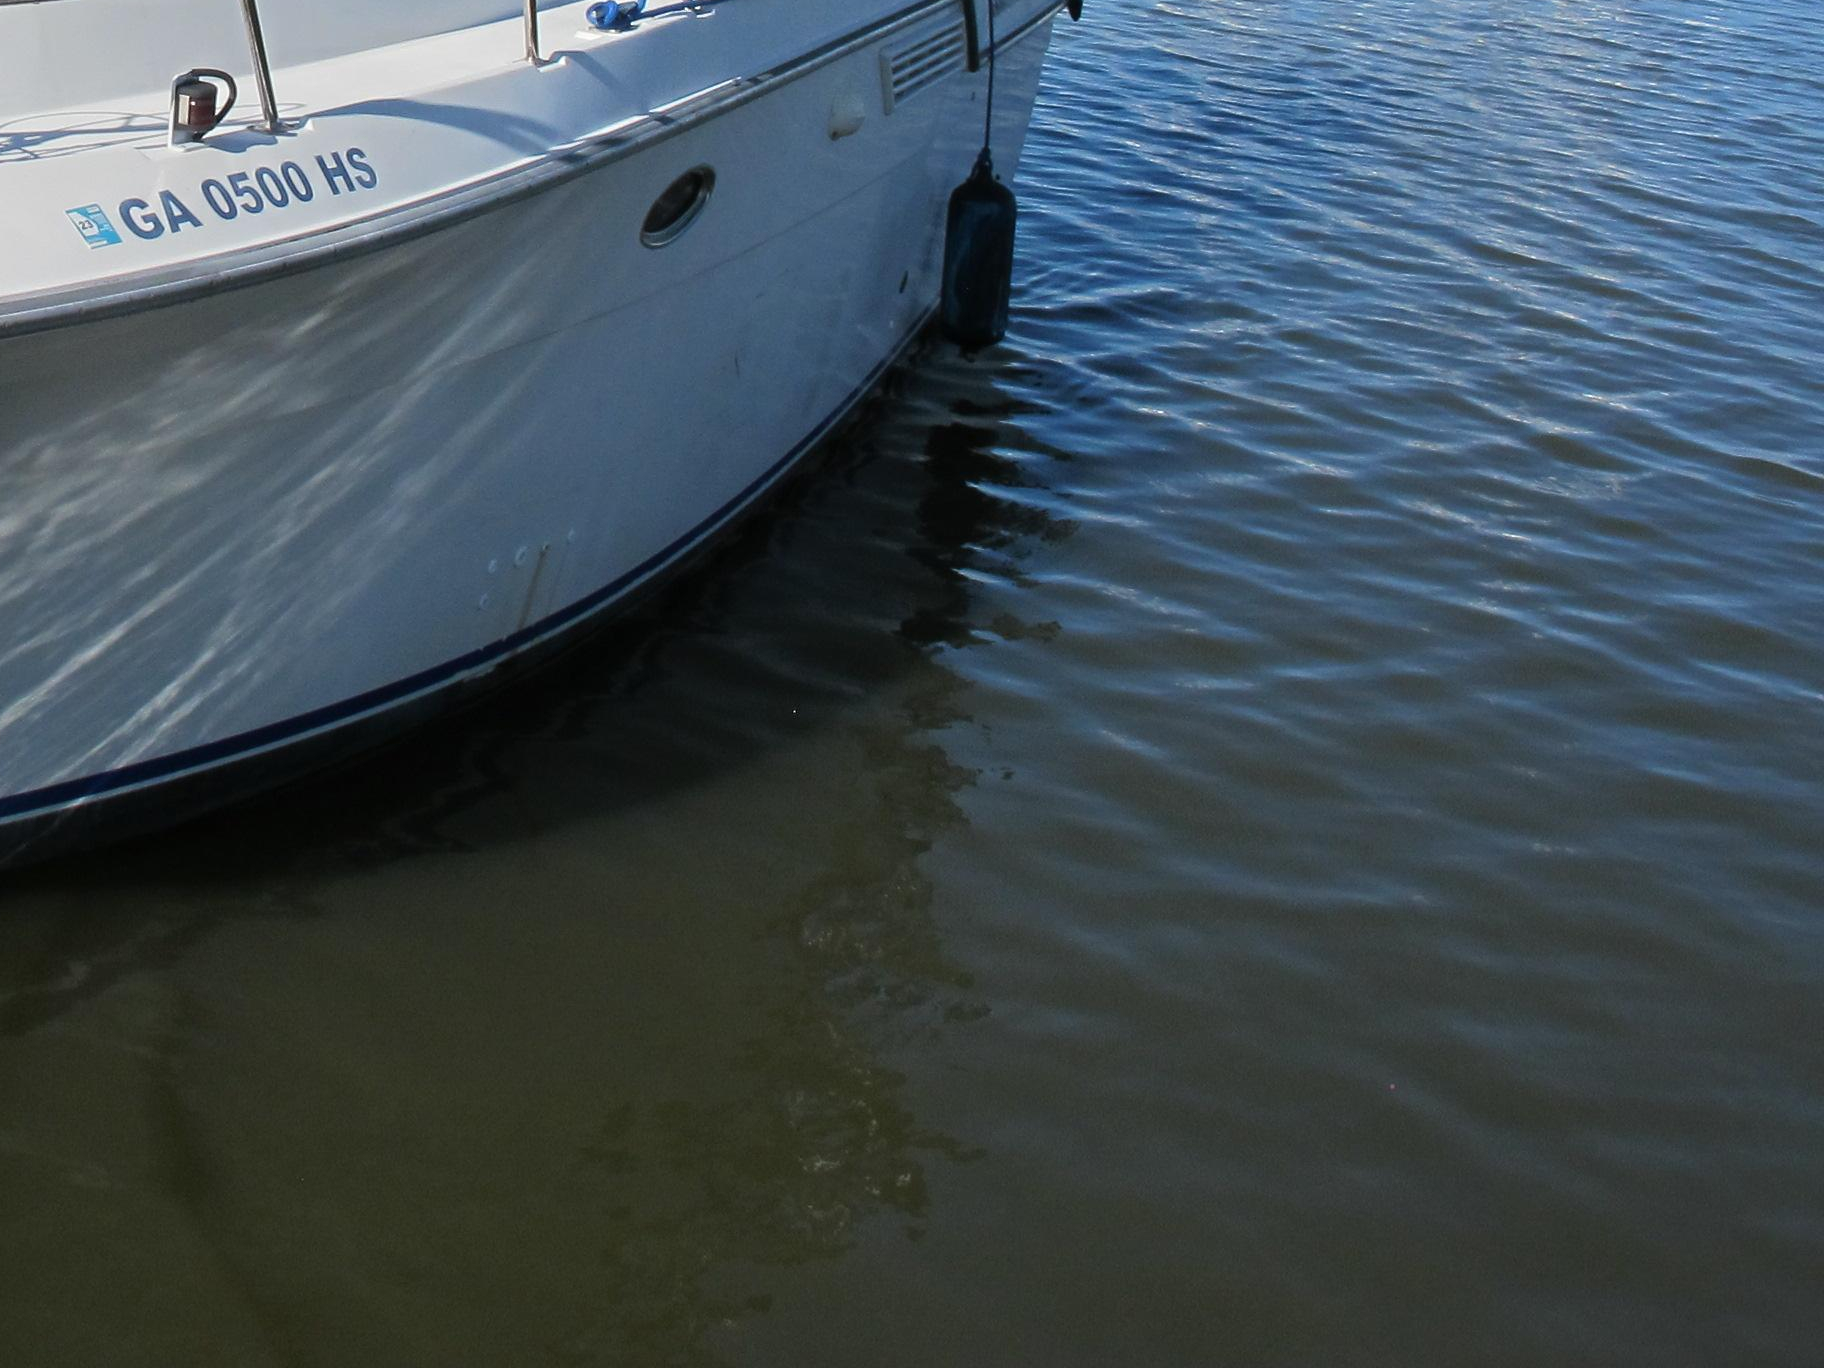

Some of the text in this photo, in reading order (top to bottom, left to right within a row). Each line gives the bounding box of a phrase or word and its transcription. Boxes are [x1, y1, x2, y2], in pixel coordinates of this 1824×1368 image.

[118, 147, 377, 240] GA 0500 HS
[78, 219, 94, 230] 23
